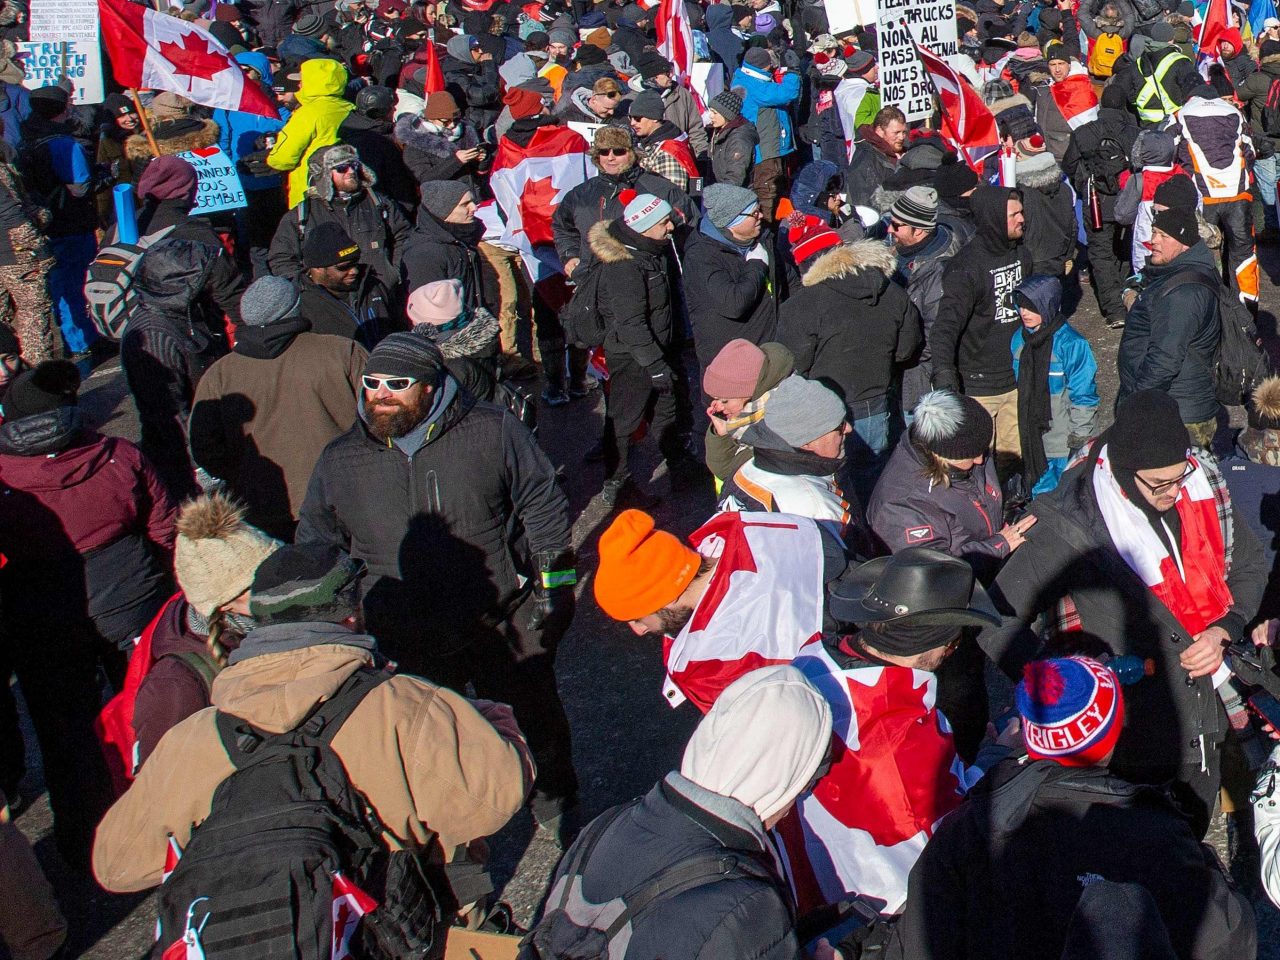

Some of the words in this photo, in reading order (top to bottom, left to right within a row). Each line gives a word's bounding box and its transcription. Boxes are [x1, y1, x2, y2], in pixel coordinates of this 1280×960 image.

[904, 4, 953, 24] TRUCKS
[921, 25, 938, 43] AU
[24, 42, 77, 55] TRUE
[25, 54, 87, 67] NORTH
[25, 66, 85, 79] STRONG
[884, 66, 918, 85] UNIS
[883, 85, 906, 102] NOS
[197, 191, 244, 208] SEMBLE
